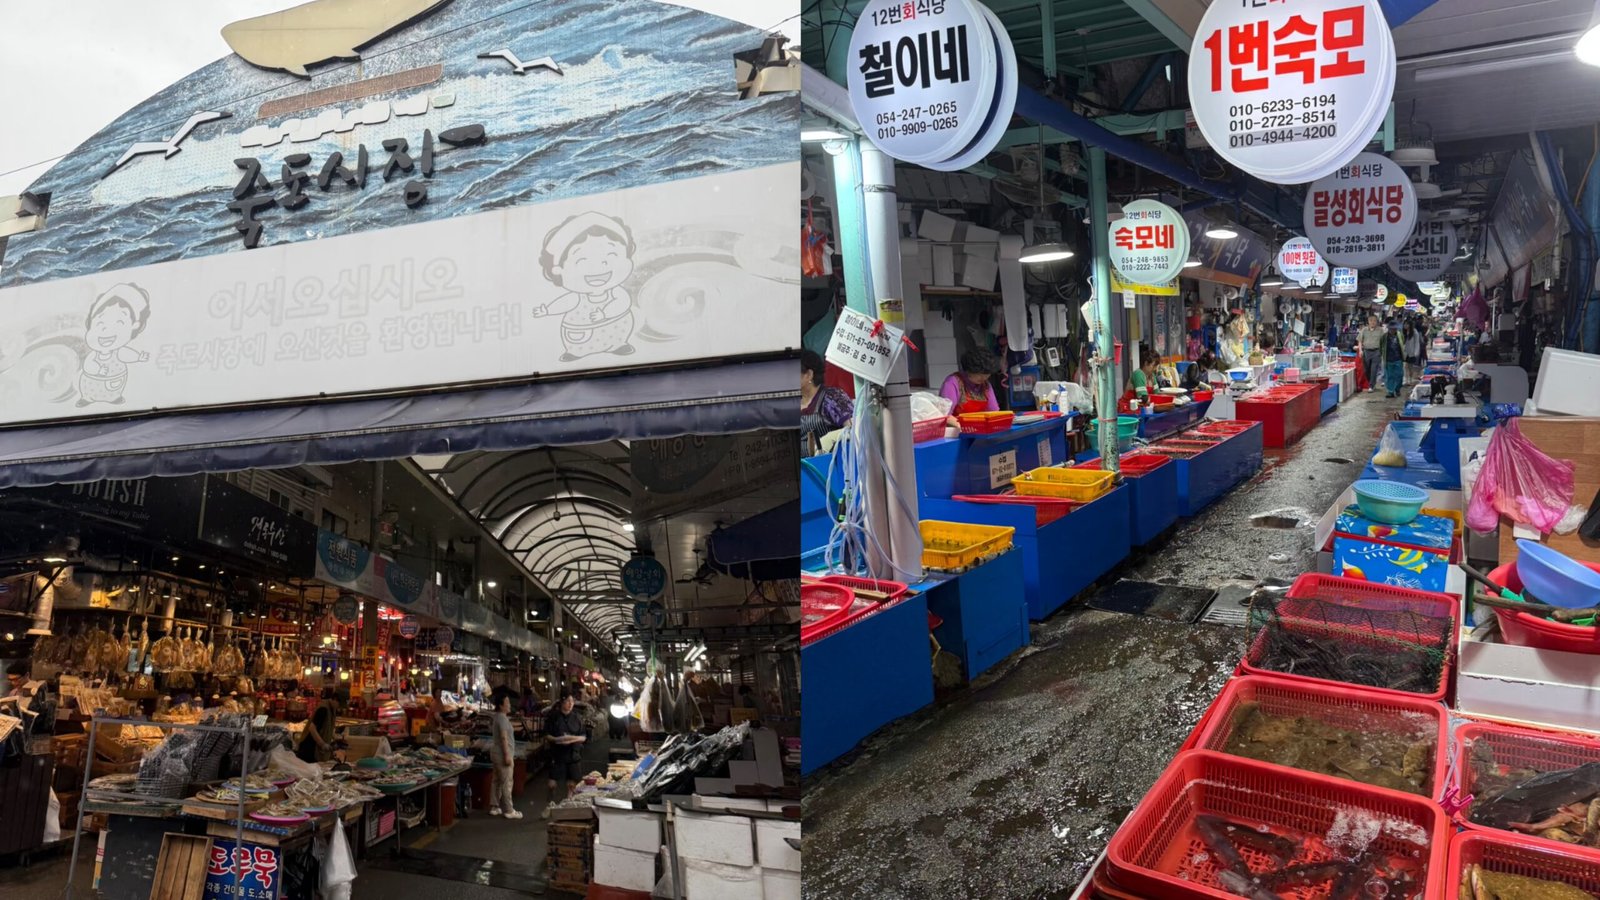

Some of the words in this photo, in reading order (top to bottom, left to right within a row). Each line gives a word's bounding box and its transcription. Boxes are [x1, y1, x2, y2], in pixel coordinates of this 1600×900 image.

[871, 0, 947, 27] 12번회식당
[858, 24, 970, 99] 철이네
[1203, 5, 1366, 93] 1번숙모
[876, 101, 957, 125] 054-247-0265
[1229, 94, 1337, 118] 010-6233-6194
[877, 116, 959, 139] 010-9909-0265
[1229, 109, 1337, 133] 010-2722-8514
[1229, 124, 1337, 148] 010-4944-4200
[226, 123, 487, 249] 죽도시장
[1313, 184, 1404, 228] 달성회식당
[1114, 224, 1175, 250] 숙모네
[1327, 234, 1385, 245] 054-243-3698
[208, 256, 464, 330] 어서오십시오
[154, 332, 267, 376] 죽도시장에
[274, 320, 372, 361] 오신것을
[380, 302, 523, 352] 환영합니다!
[208, 845, 278, 889] 도루묵
